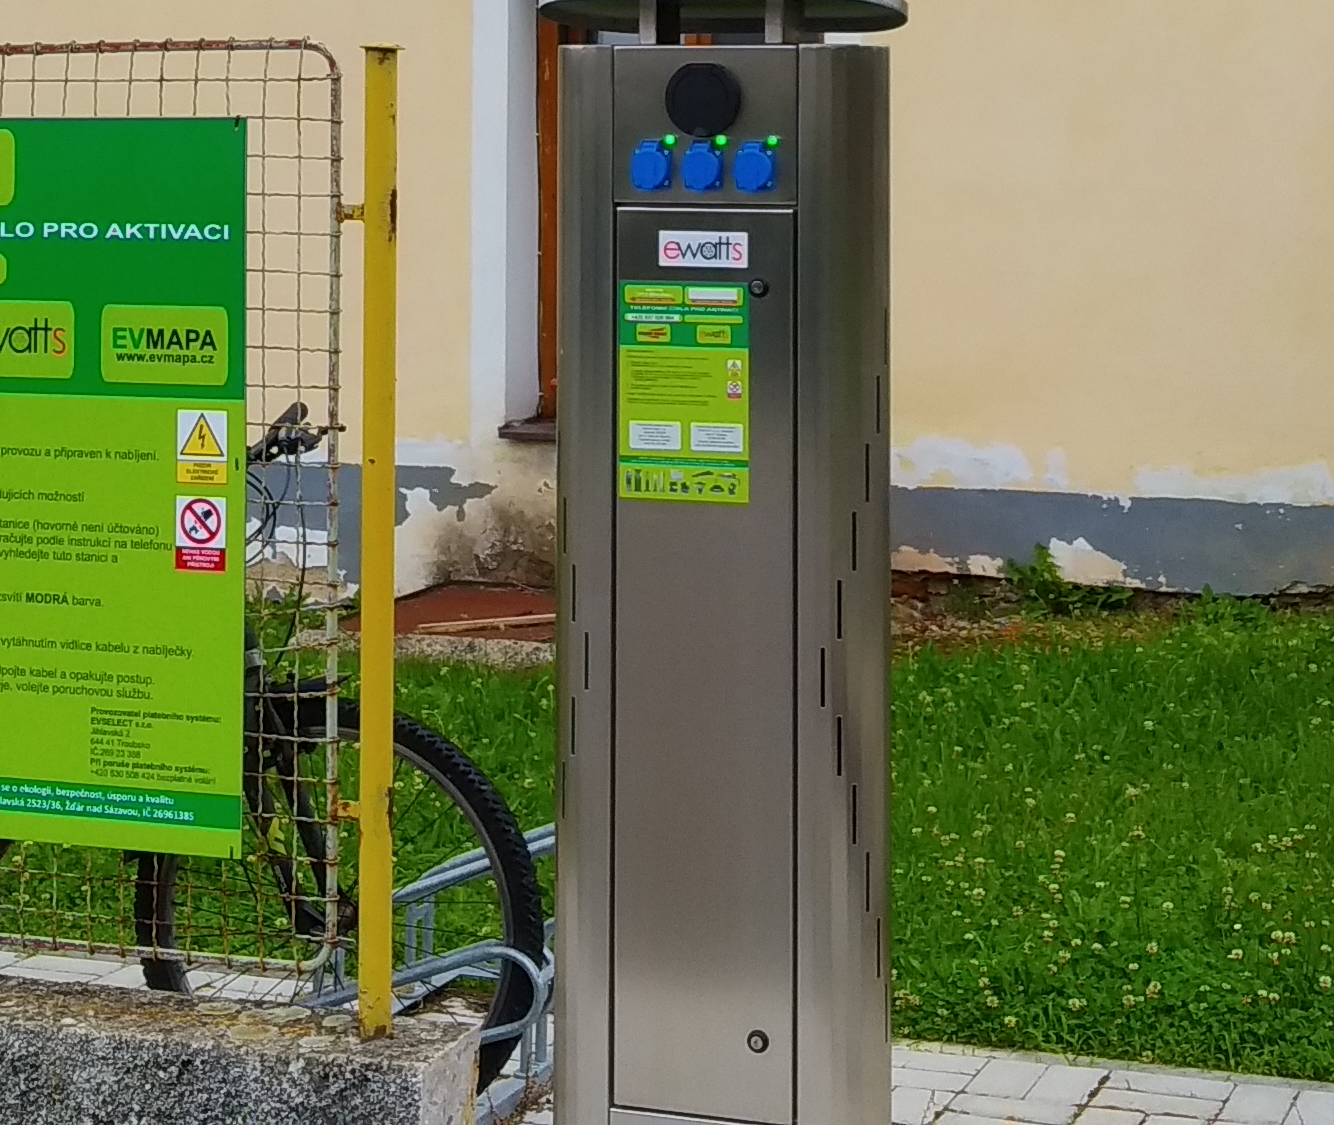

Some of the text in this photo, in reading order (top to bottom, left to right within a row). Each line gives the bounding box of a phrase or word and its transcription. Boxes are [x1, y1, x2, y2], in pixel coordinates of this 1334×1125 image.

[42, 221, 99, 238] PRO
[104, 222, 229, 240] AKTIVACI
[663, 235, 743, 263] ewatts
[112, 327, 218, 351] EVMAPA
[116, 350, 215, 367] www.evmapa.cz
[0, 446, 42, 457] provozu
[43, 447, 51, 457] a
[53, 446, 102, 460] připraven
[104, 448, 111, 459] k
[106, 522, 159, 537] účtováno)
[35, 534, 65, 547] podle
[113, 539, 127, 549] na
[129, 538, 173, 551] telefonu
[51, 550, 72, 561] tuto
[74, 551, 108, 563] stanici
[110, 553, 118, 563] a
[24, 591, 69, 605] MODRÁ
[58, 638, 92, 651] vidlice
[94, 640, 130, 653] kabelu
[132, 644, 139, 654] z
[28, 666, 57, 678] kabel
[59, 670, 67, 679] a
[68, 669, 114, 684] opakujte
[115, 673, 155, 687] postup.
[15, 681, 49, 695] volejte
[51, 684, 113, 697] poruchovou
[115, 686, 153, 700] službu.
[90, 717, 134, 727] EVSELECT
[0, 783, 10, 792] se
[11, 784, 18, 793] o
[105, 791, 137, 802] úsporu
[137, 794, 143, 803] a
[144, 793, 174, 805] kvalitu
[25, 798, 63, 811] 2523/36,
[85, 803, 103, 813] nad
[141, 805, 151, 817] IČ
[151, 808, 194, 821] 26961385
